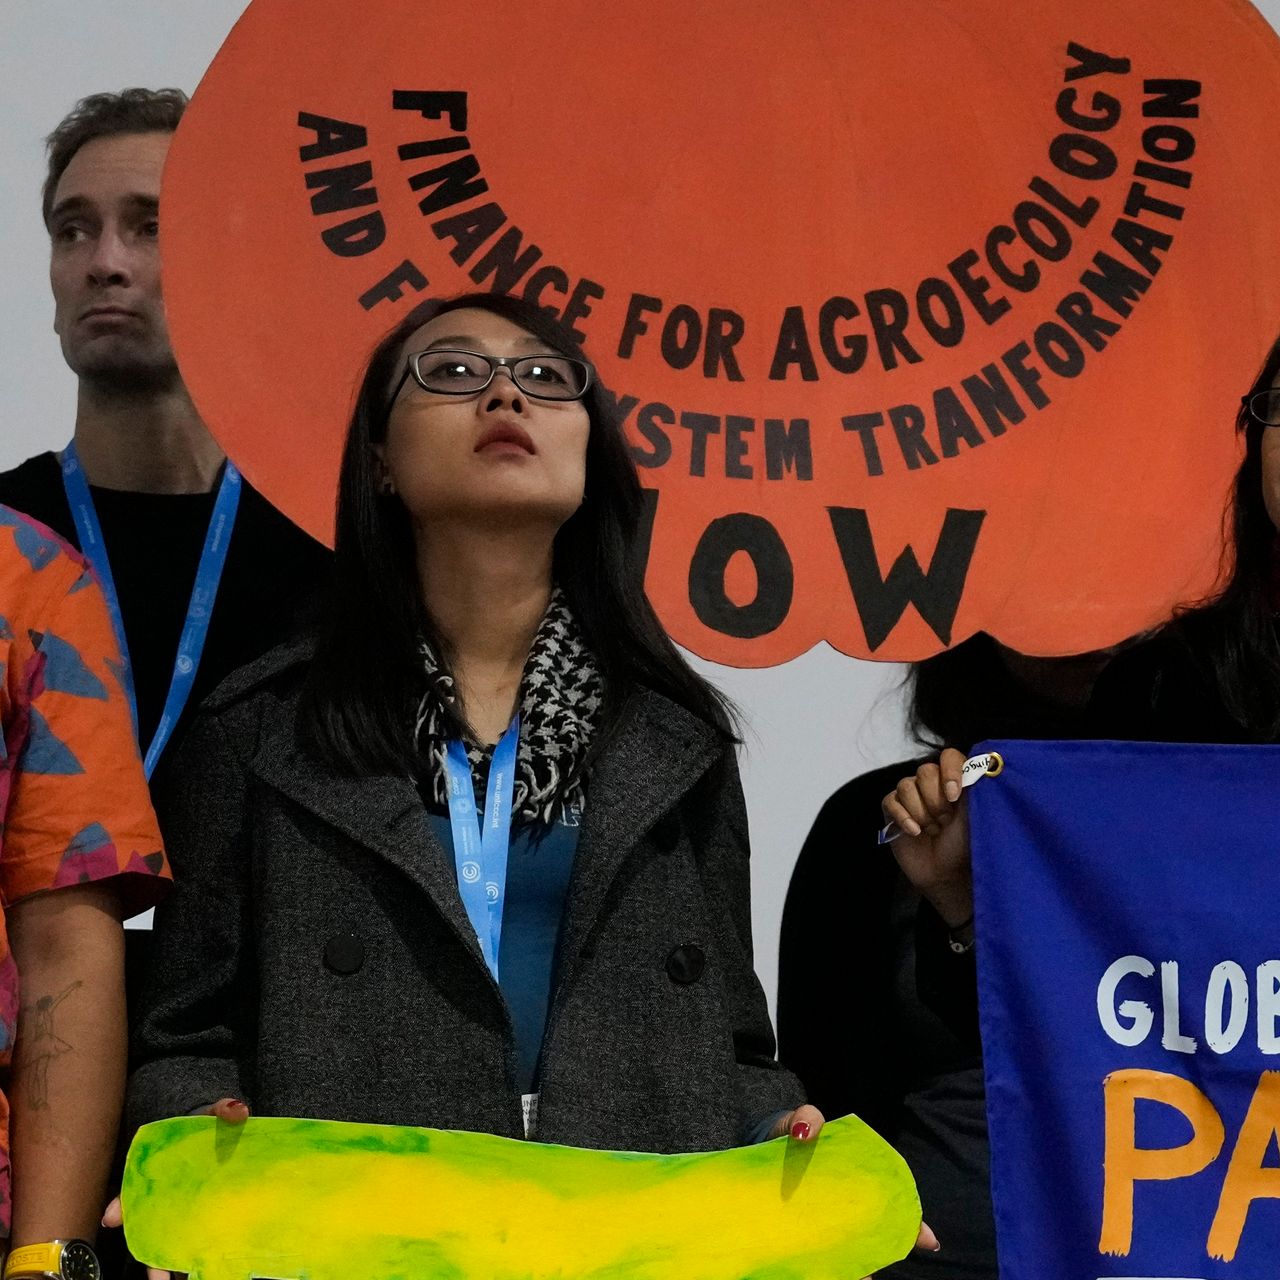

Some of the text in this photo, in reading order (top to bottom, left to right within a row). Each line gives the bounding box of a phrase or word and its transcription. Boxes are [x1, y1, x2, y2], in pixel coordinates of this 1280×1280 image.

[298, 110, 387, 258] AND
[840, 78, 1202, 477] TRANFORMATION
[392, 41, 1131, 382] FINANCE FOR AGROECOLOGY
